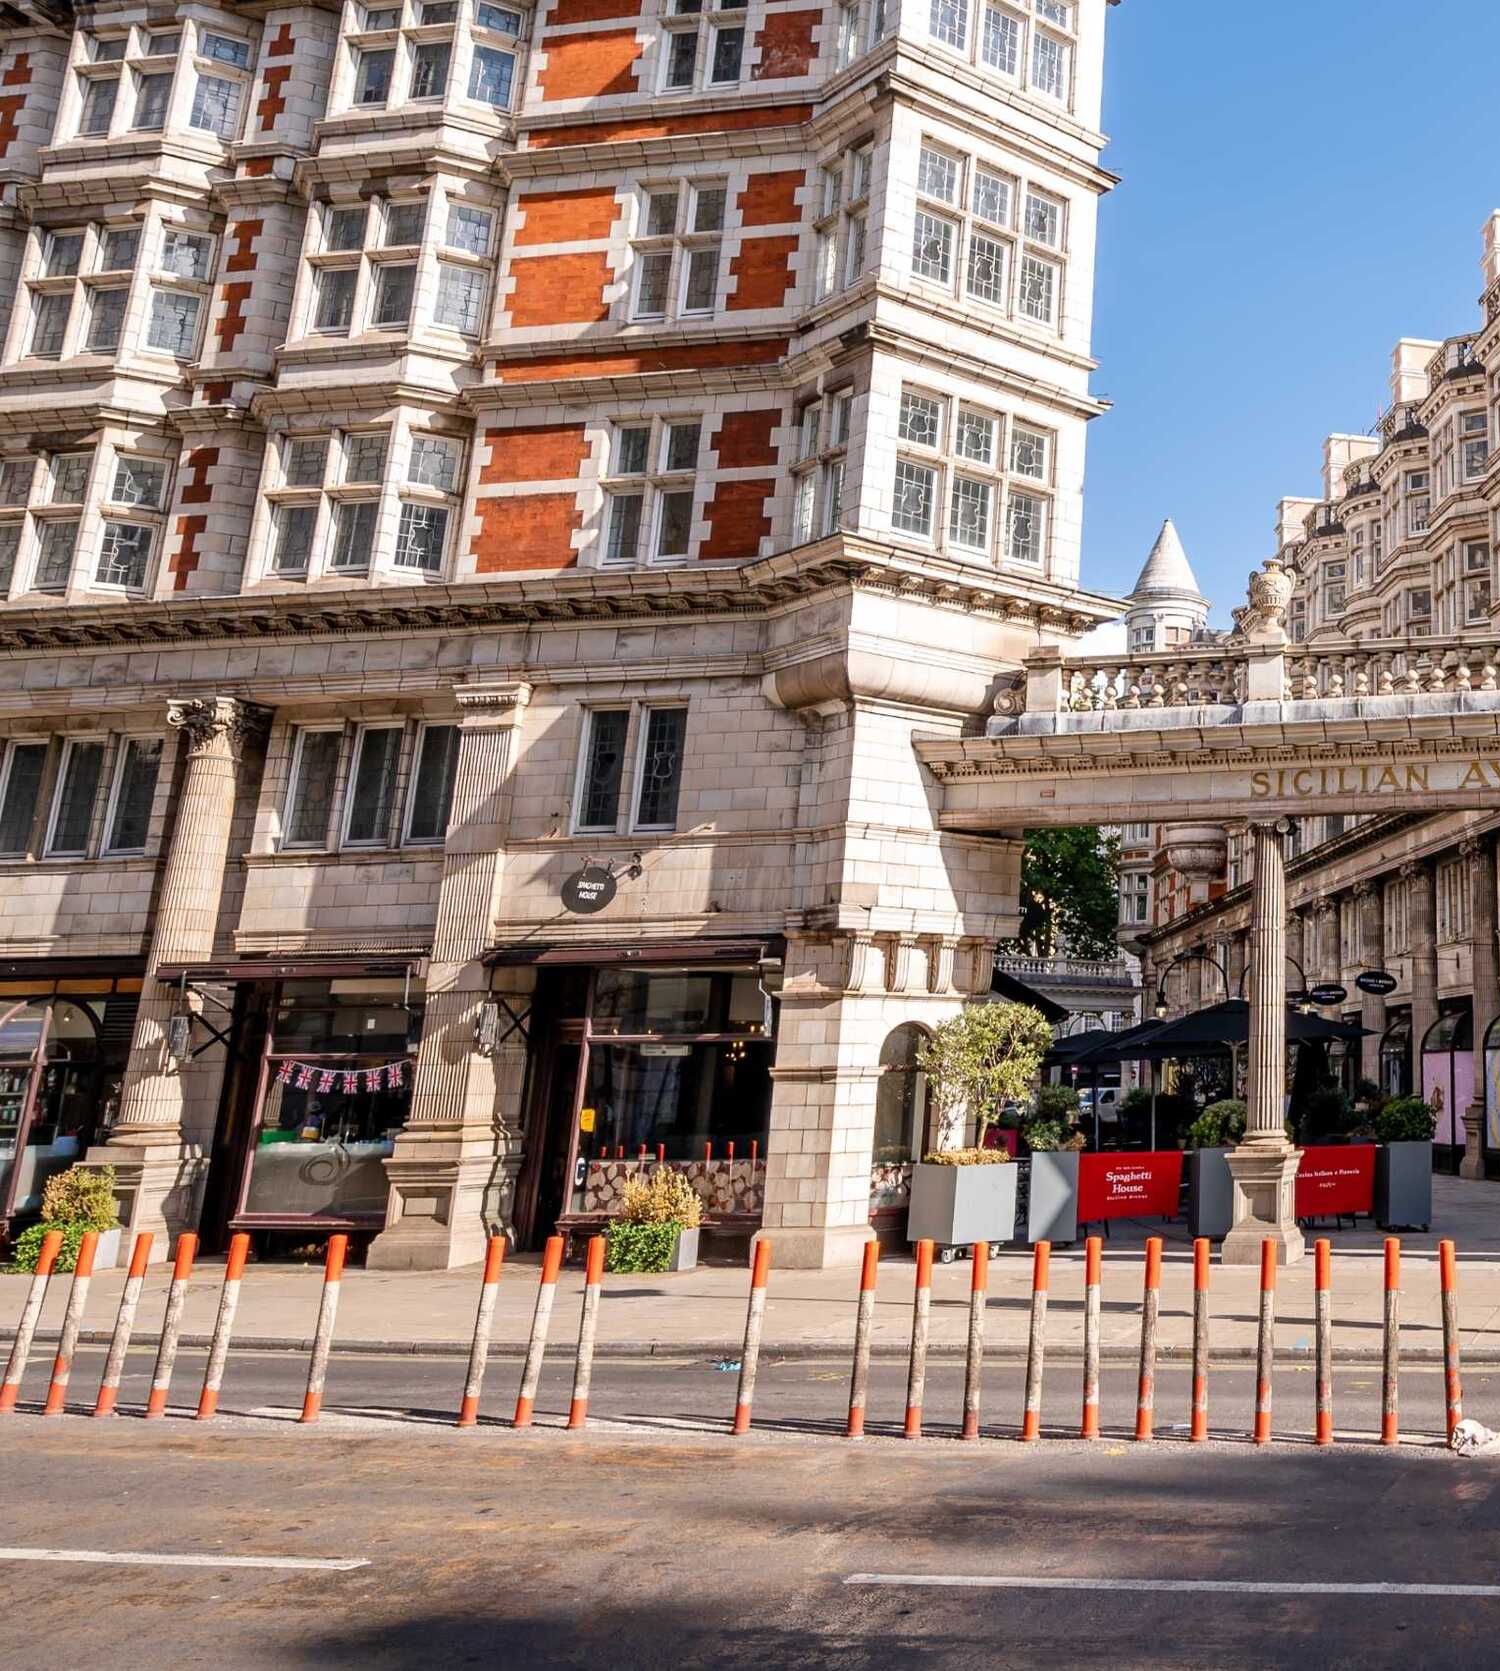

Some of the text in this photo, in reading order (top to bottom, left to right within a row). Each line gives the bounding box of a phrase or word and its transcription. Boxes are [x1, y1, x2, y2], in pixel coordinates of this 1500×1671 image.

[1251, 764, 1430, 798] SICILIAN
[1105, 1171, 1152, 1183] Spaghetti
[1112, 1183, 1144, 1194] House
